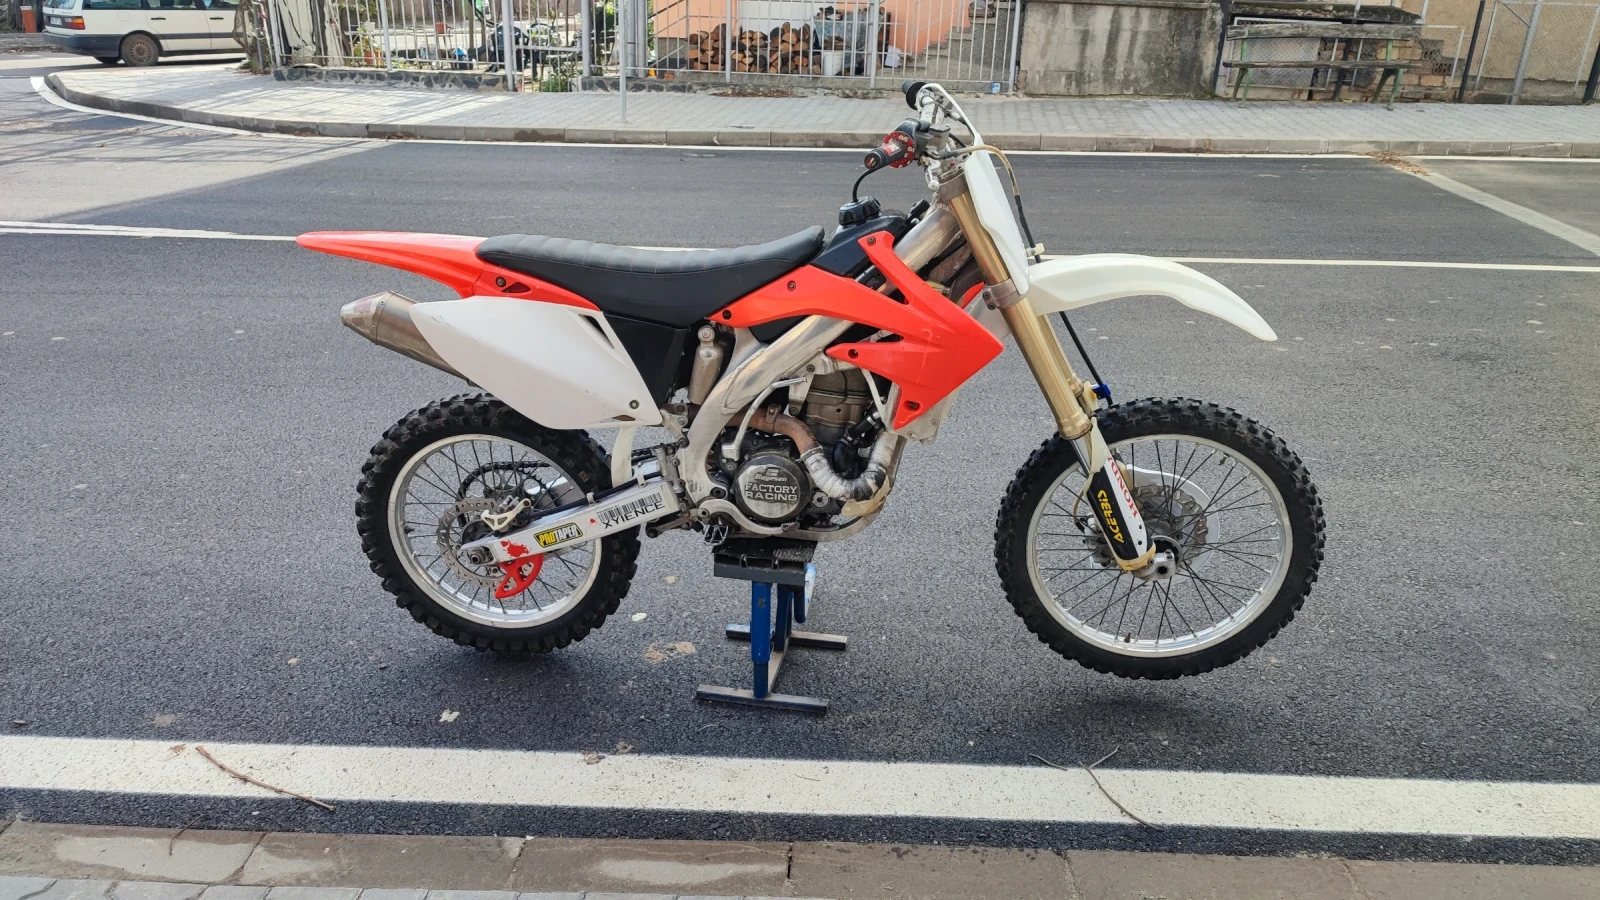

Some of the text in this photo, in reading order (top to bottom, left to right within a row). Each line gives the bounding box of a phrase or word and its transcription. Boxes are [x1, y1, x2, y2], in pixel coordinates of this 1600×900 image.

[745, 483, 798, 494] FACTORY
[745, 491, 798, 501] RACING
[600, 502, 666, 529] XYIENCE
